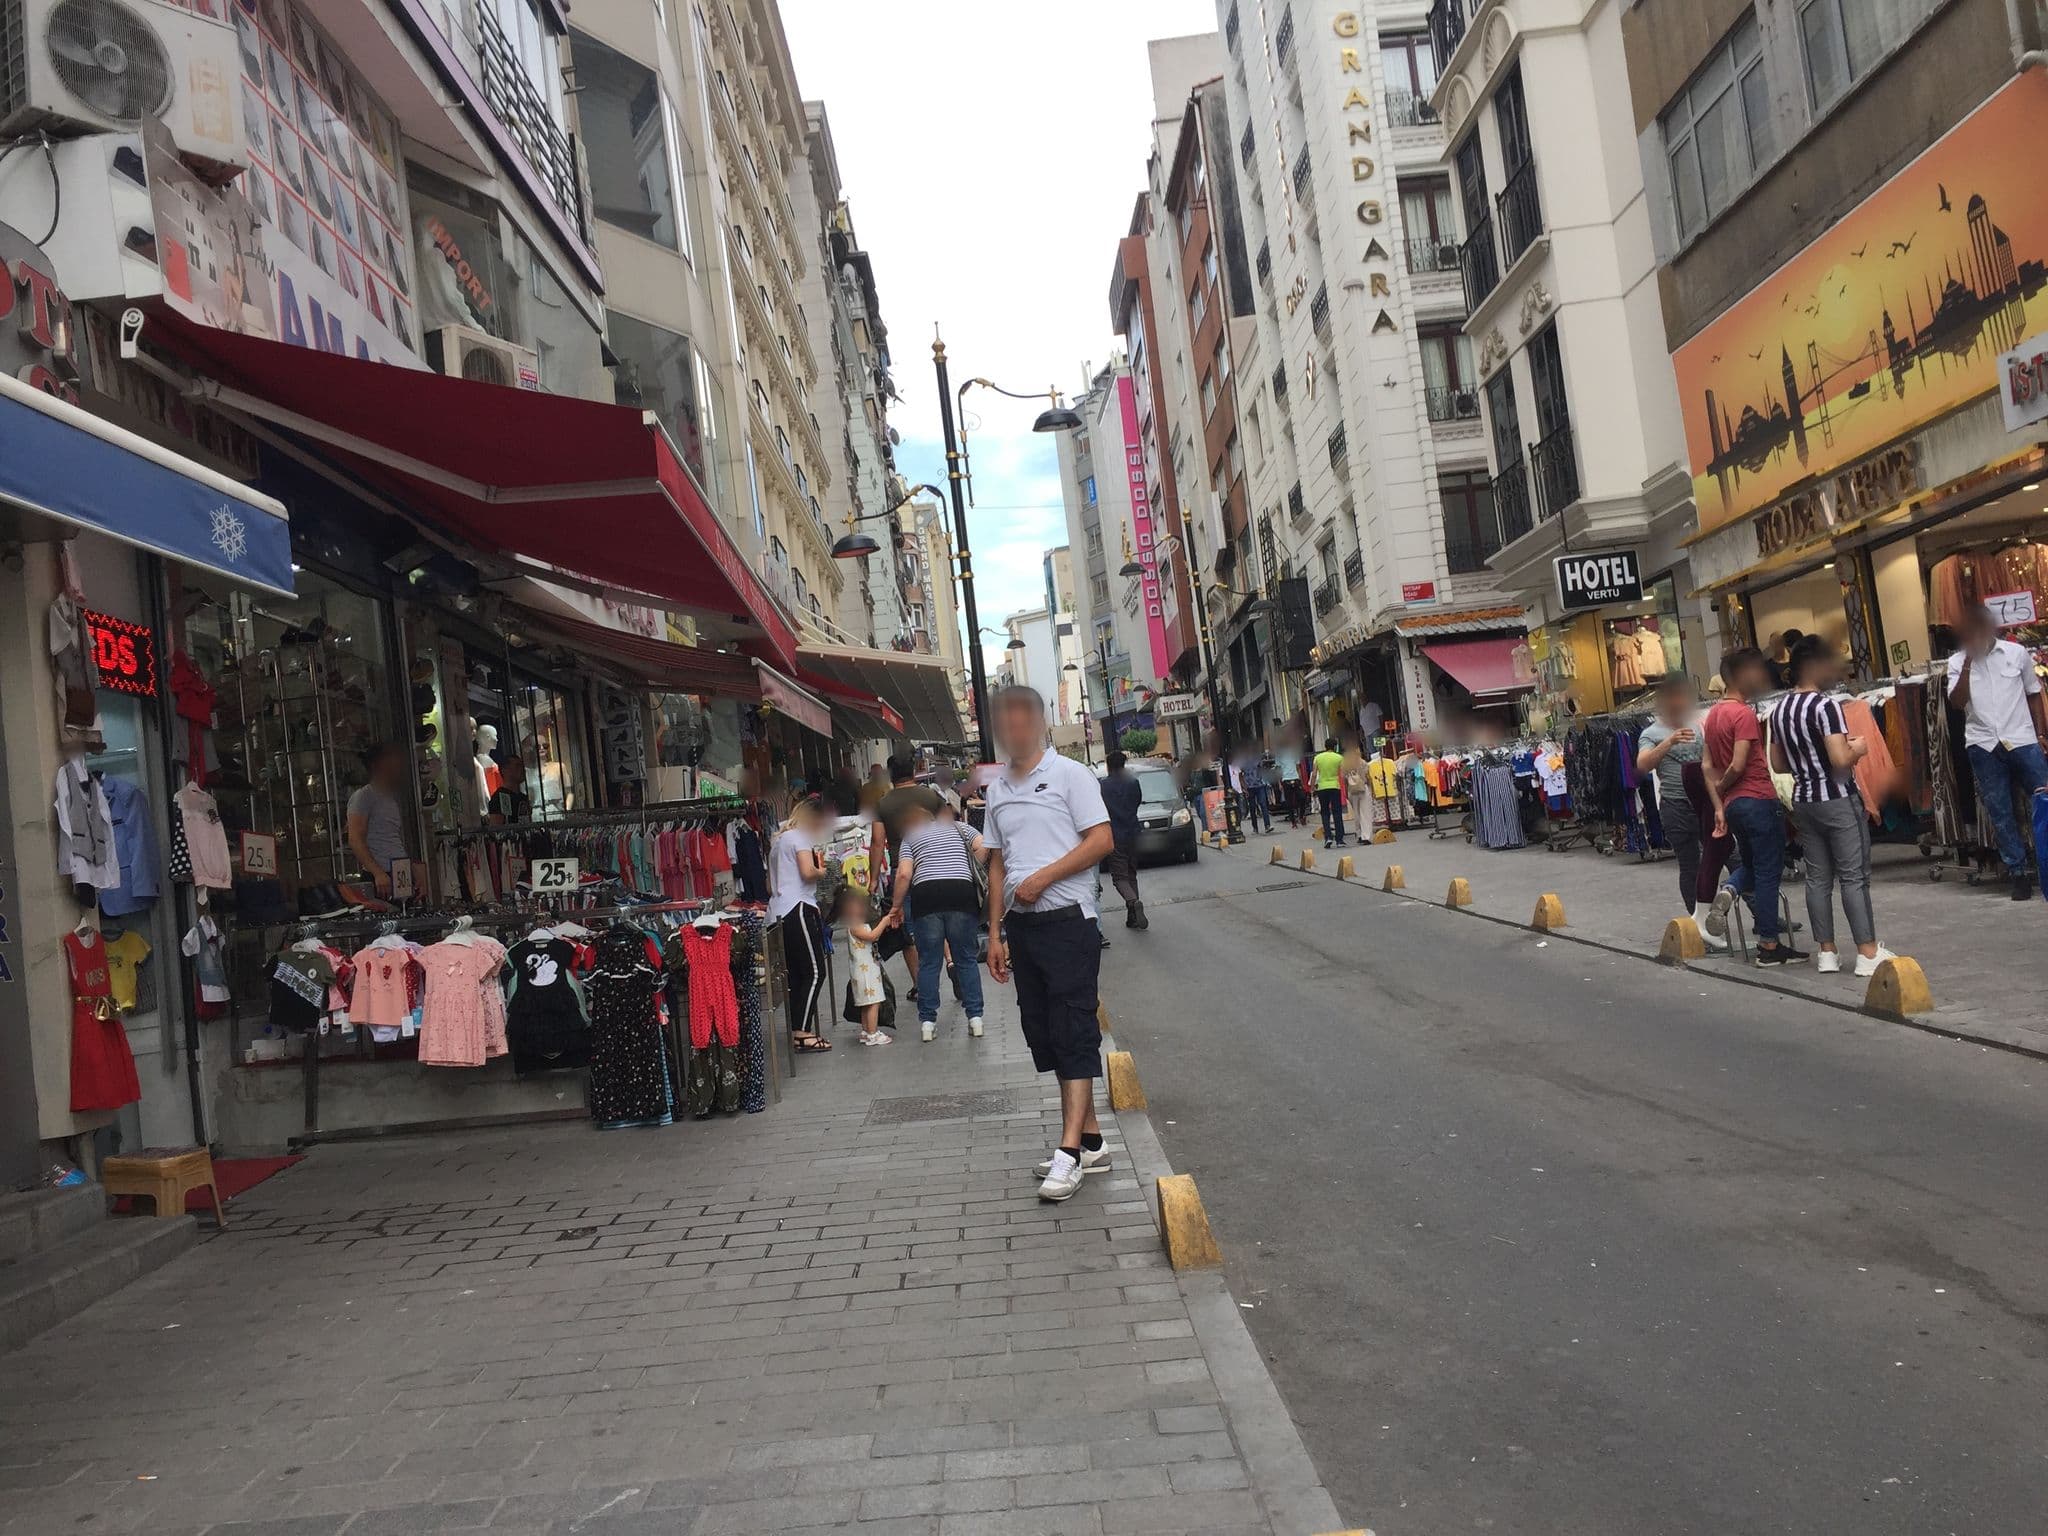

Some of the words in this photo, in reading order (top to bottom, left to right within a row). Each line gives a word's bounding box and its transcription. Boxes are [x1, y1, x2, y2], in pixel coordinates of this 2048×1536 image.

[427, 215, 492, 310] IMPORT
[1357, 199, 1398, 334] GARA
[1564, 556, 1636, 591] HOTEL
[1586, 588, 1621, 601] VERTU
[1989, 596, 2032, 624] 75
[1162, 699, 1194, 713] HOTEL
